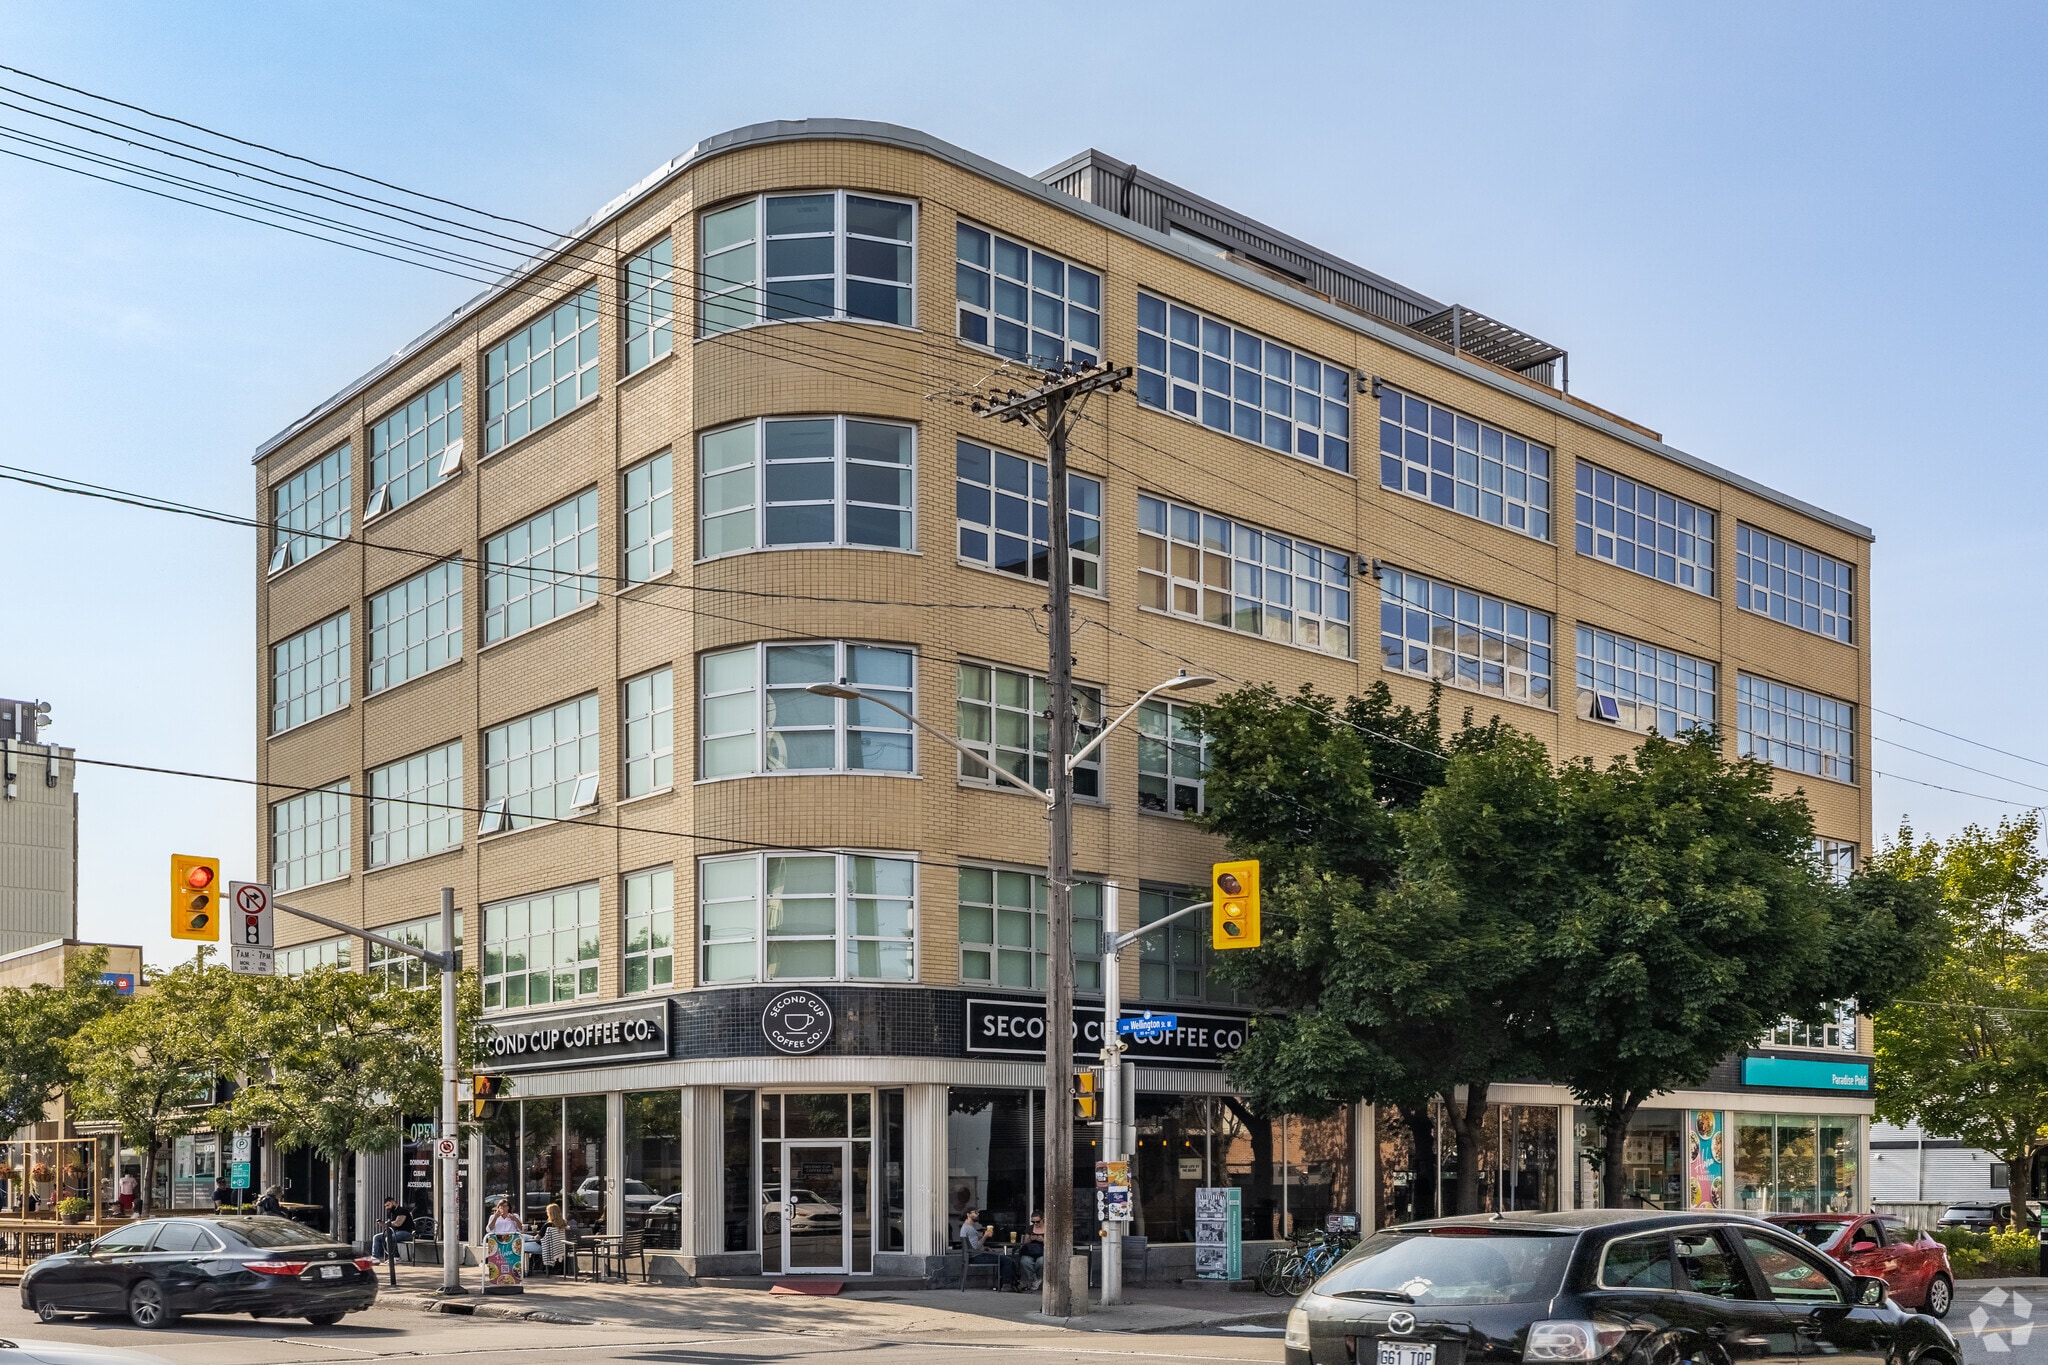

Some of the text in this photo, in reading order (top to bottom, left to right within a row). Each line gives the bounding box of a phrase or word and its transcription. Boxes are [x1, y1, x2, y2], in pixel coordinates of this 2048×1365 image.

[770, 996, 824, 1017] SECOND CUP
[1130, 1020, 1160, 1031] Wellington
[479, 1033, 527, 1056] COND
[530, 1030, 559, 1051] CUP
[563, 1021, 620, 1048] COFFEE
[772, 1030, 805, 1048] COFFEE
[1832, 1074, 1853, 1085] Paradise
[1381, 1350, 1431, 1365] G61 TQP
